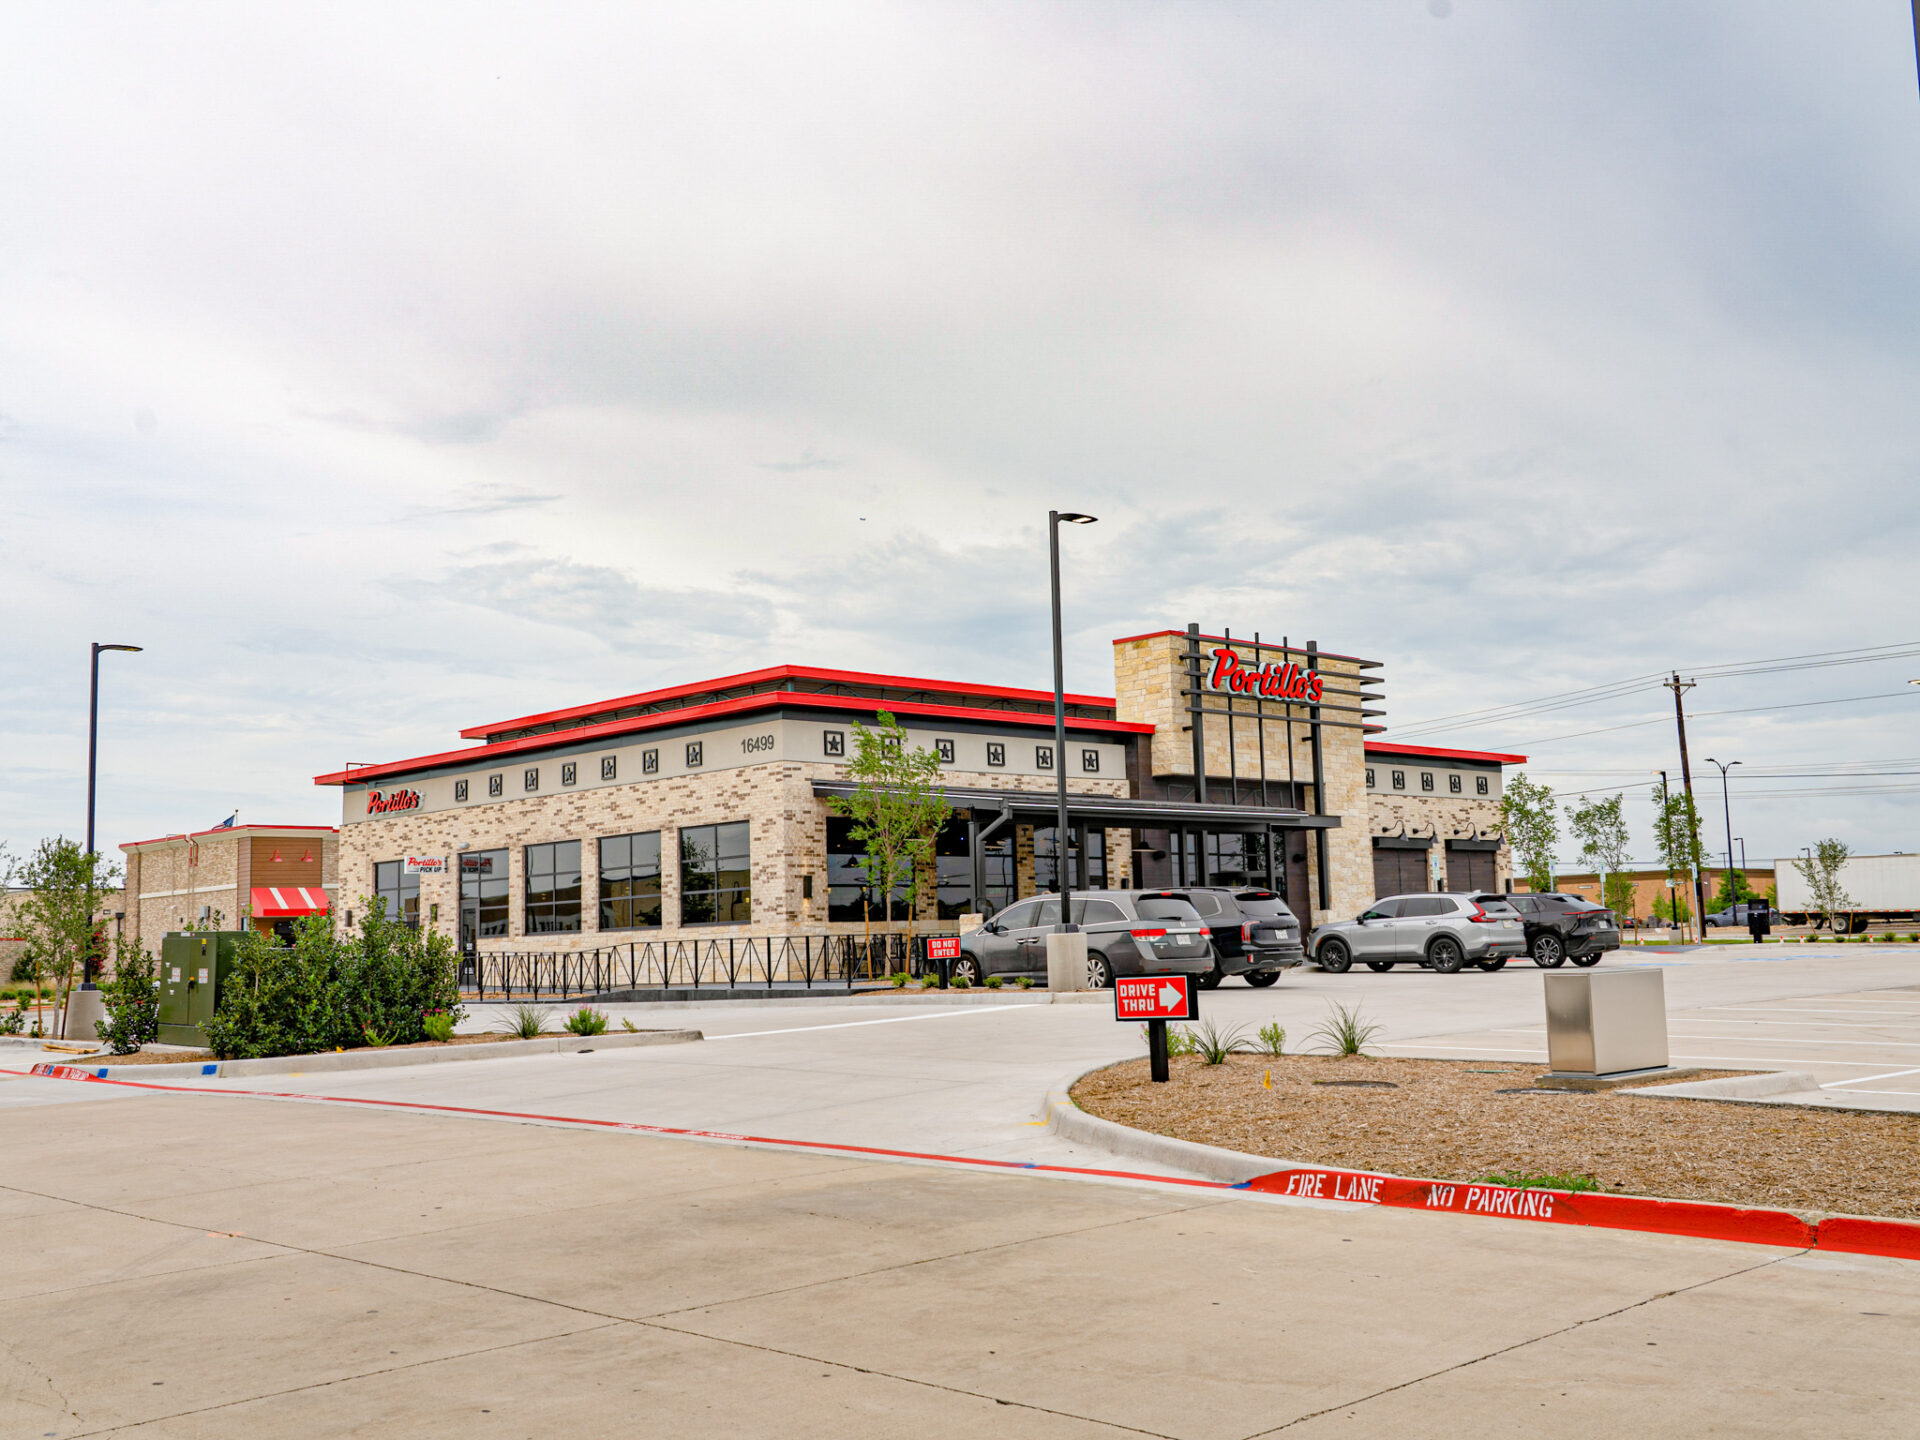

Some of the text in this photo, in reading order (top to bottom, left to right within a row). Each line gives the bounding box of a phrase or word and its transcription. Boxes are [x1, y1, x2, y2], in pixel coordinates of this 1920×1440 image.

[1211, 648, 1324, 702] Portillo's
[741, 734, 774, 754] 16499
[367, 788, 420, 814] Portillo's
[943, 940, 956, 948] NOT
[933, 949, 955, 957] ENTER
[1120, 984, 1156, 997] DRIVE
[1122, 998, 1155, 1012] THRU
[1285, 1173, 1554, 1218] FIRE LANE NO PARKING
